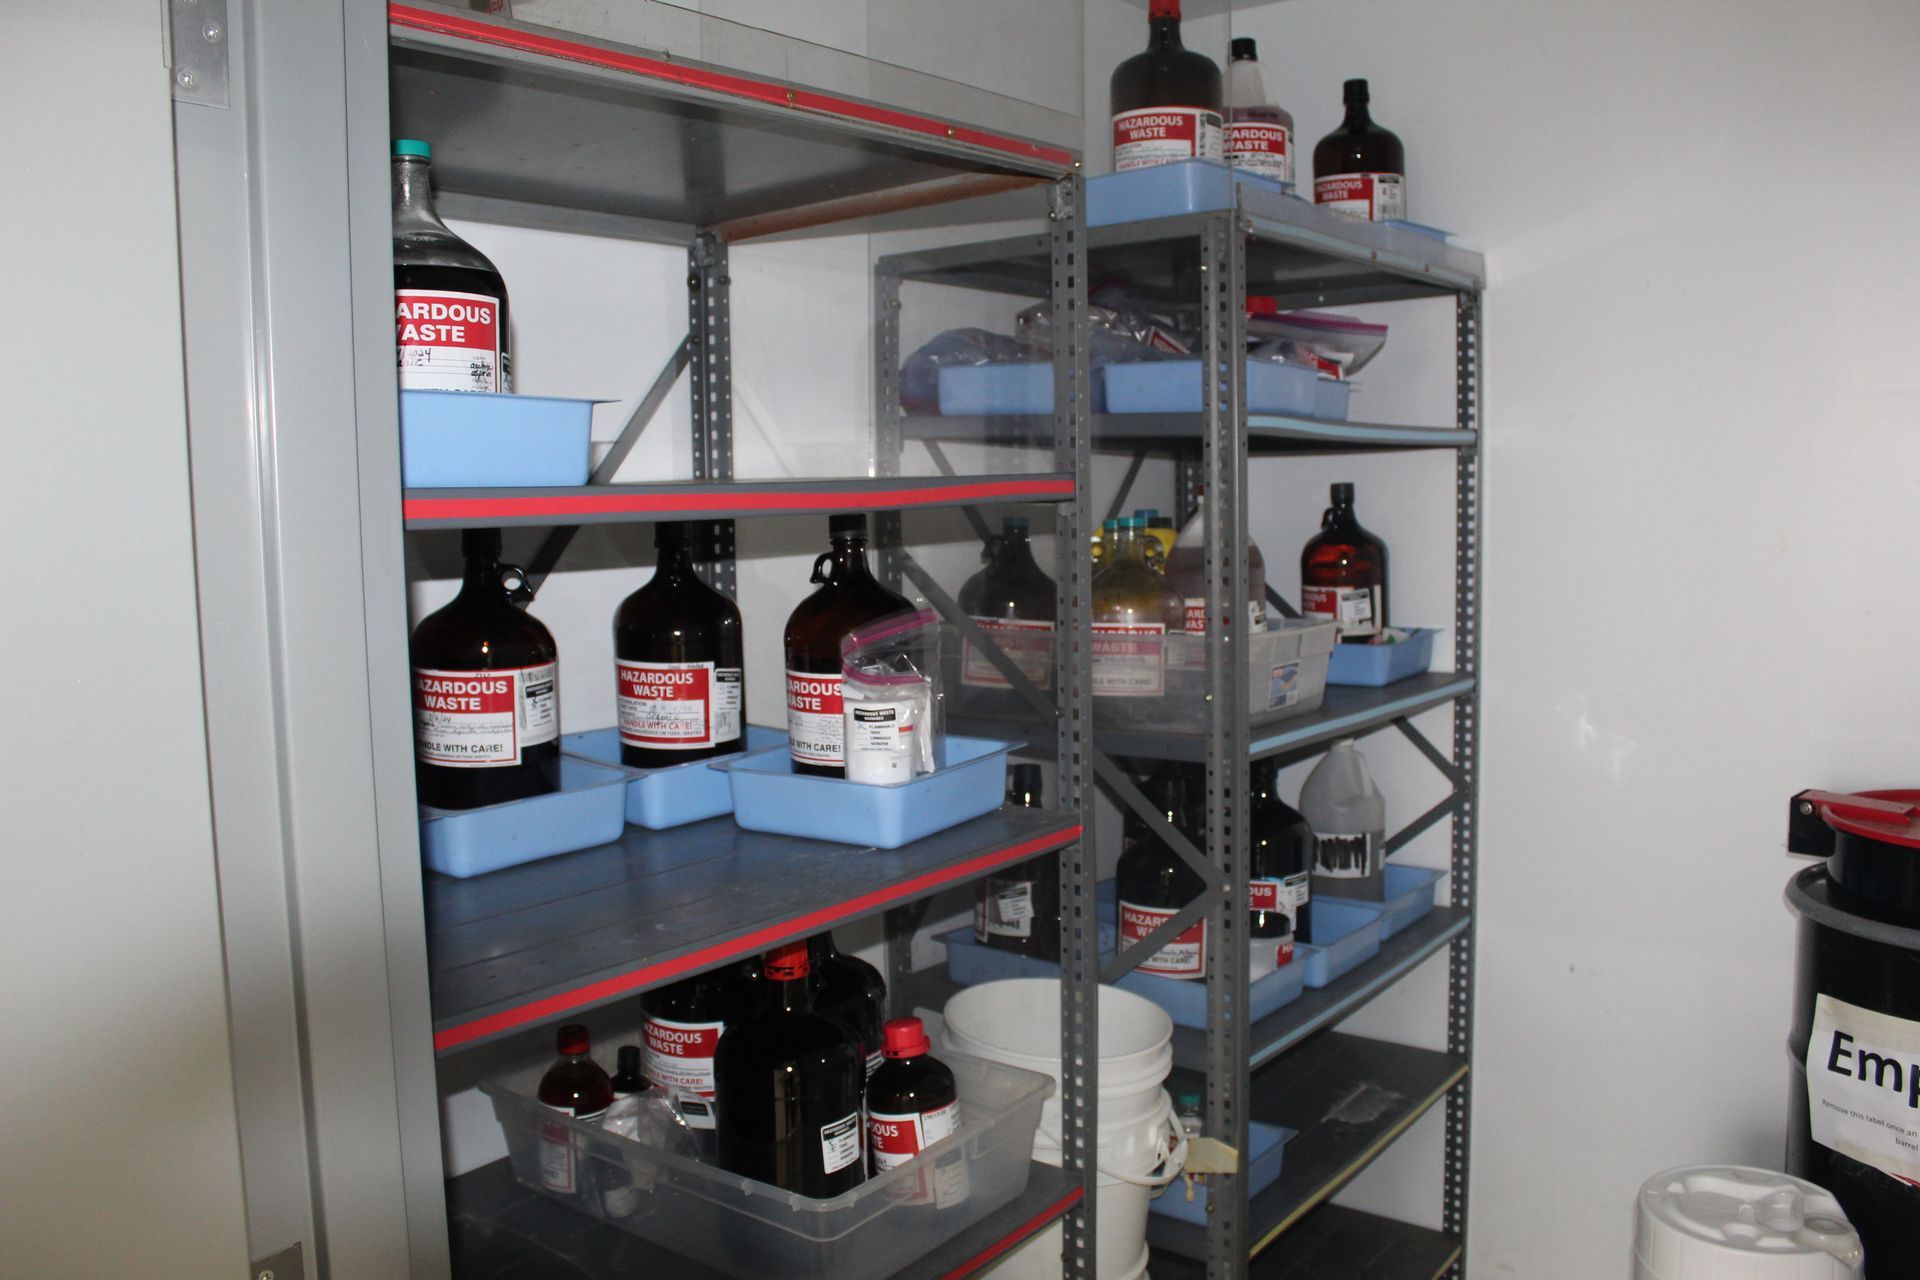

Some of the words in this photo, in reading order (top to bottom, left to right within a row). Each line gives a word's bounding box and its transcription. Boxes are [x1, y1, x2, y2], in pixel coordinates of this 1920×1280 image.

[1119, 115, 1184, 131] HAZARDOUS
[1130, 127, 1167, 140] WASTE
[1322, 190, 1349, 201] WASTE
[397, 303, 491, 325] ARDOUS
[620, 669, 694, 685] HAZARDOUS
[633, 684, 675, 698] WASTE
[788, 680, 842, 696] ARDOUS
[424, 694, 482, 711] WASTE
[647, 720, 668, 730] WITH
[669, 722, 694, 731] CAE!
[443, 744, 467, 754] WITH
[471, 744, 503, 754] CARE!
[796, 740, 812, 750] WITH
[813, 743, 842, 753] CARE!
[1124, 911, 1169, 927] HAZAR
[649, 1036, 684, 1055] WASTE
[1822, 1098, 1848, 1114] Remove
[1850, 1110, 1864, 1120] this
[1866, 1115, 1884, 1127] label
[1886, 1122, 1905, 1134] once
[1896, 1137, 1918, 1151] barrel
